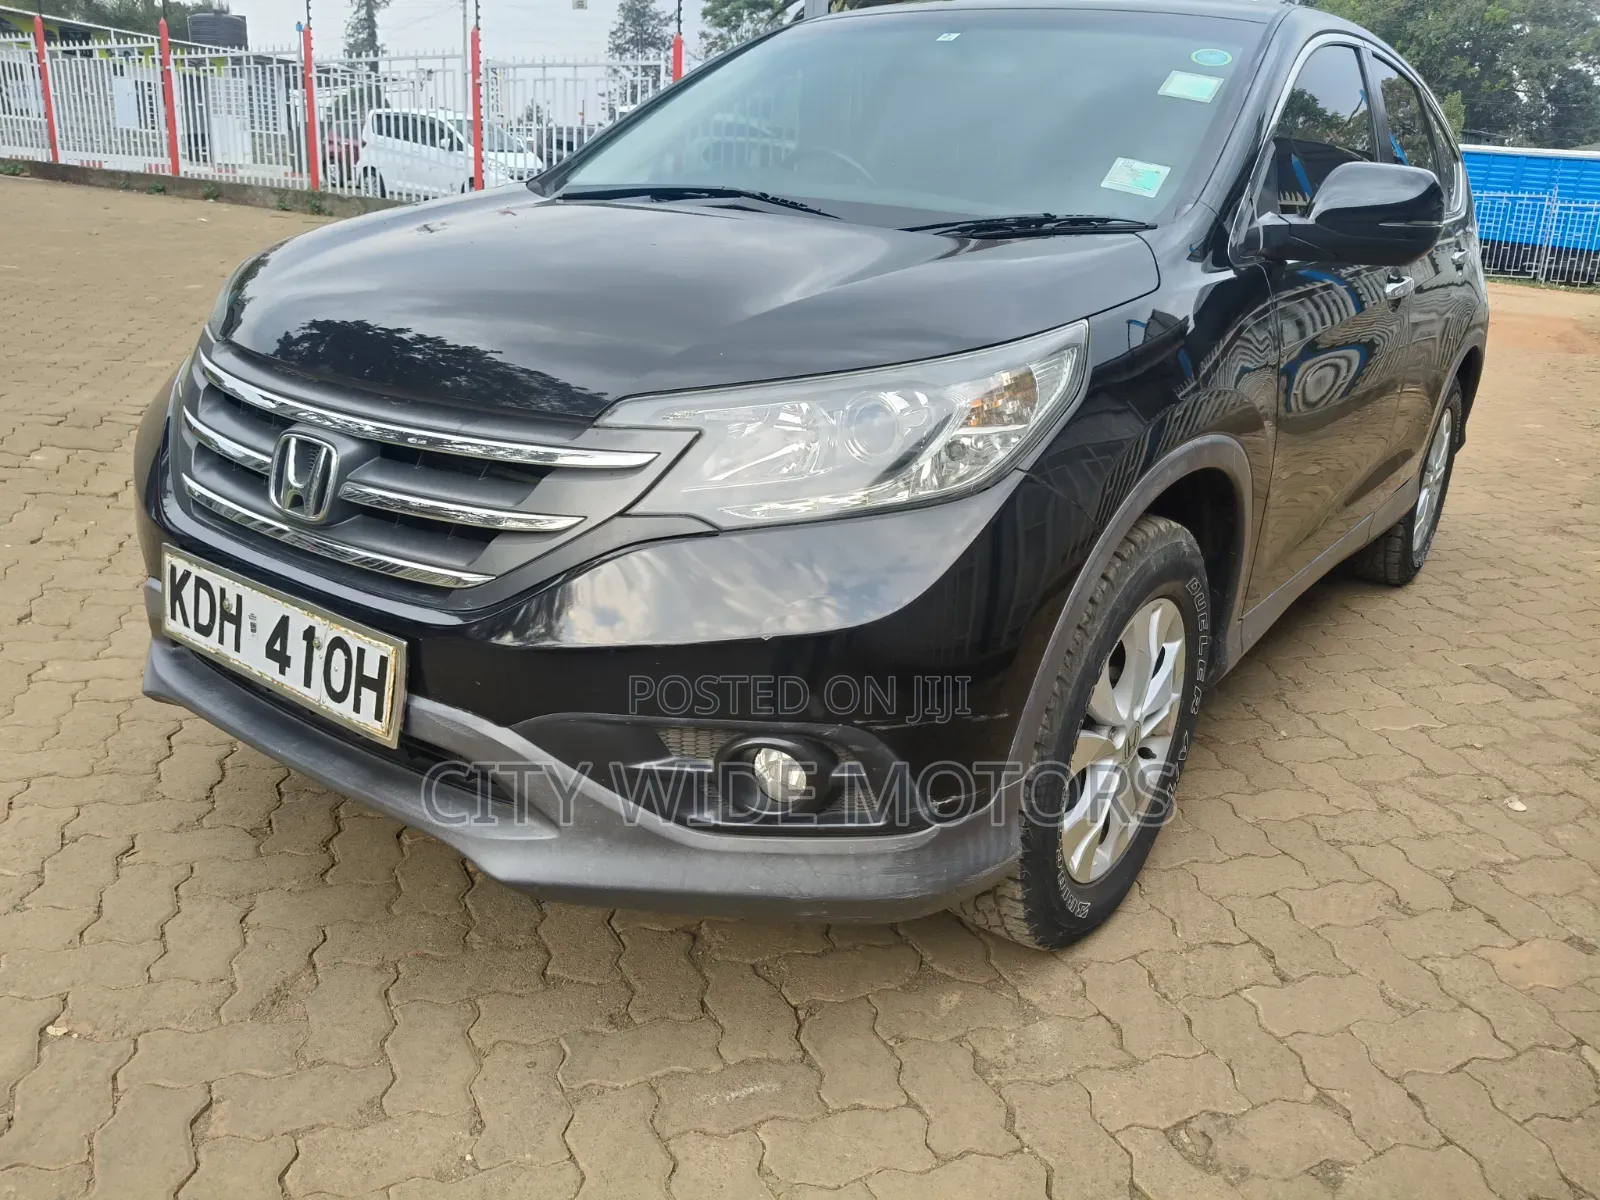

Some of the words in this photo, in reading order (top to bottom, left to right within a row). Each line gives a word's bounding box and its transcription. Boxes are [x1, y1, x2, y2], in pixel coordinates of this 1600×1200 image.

[170, 563, 243, 654] KDH
[265, 613, 389, 723] 410H
[1185, 577, 1209, 715] DUELER
